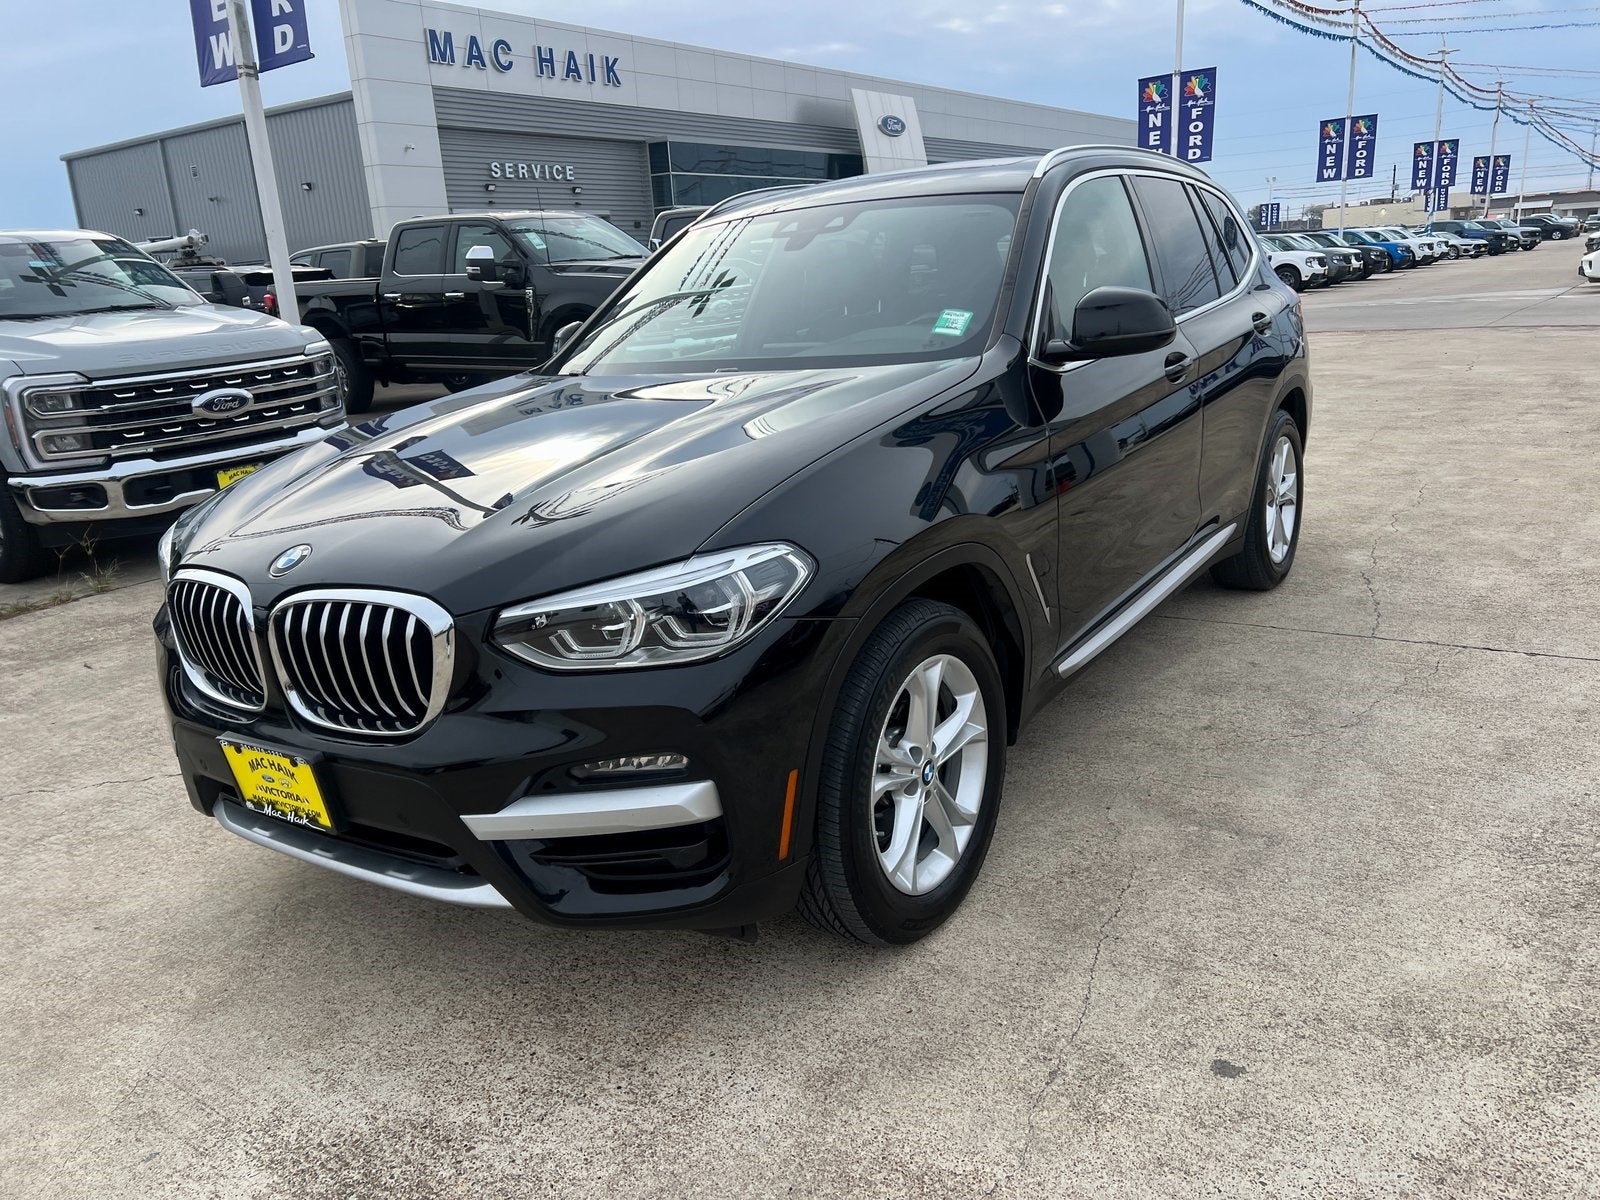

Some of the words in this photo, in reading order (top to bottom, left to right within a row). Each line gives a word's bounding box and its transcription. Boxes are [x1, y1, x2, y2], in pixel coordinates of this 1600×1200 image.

[425, 28, 513, 73] MAC
[534, 45, 622, 87] HAIK
[887, 118, 901, 131] Ford
[1187, 107, 1203, 160] FORD
[491, 161, 575, 180] SERVICE
[1323, 144, 1336, 178] NEW
[1355, 140, 1367, 177] FORD
[1416, 160, 1427, 187] NEW
[1441, 158, 1450, 186] FORD
[1475, 171, 1484, 192] NEW
[1494, 169, 1503, 192] FORD
[212, 396, 239, 411] Ford
[228, 470, 240, 480] MAC
[248, 757, 268, 773] MAC
[268, 758, 299, 784] HAIK
[262, 786, 305, 803] VICTORIA
[262, 804, 286, 819] Mac
[287, 811, 320, 829] Haik
